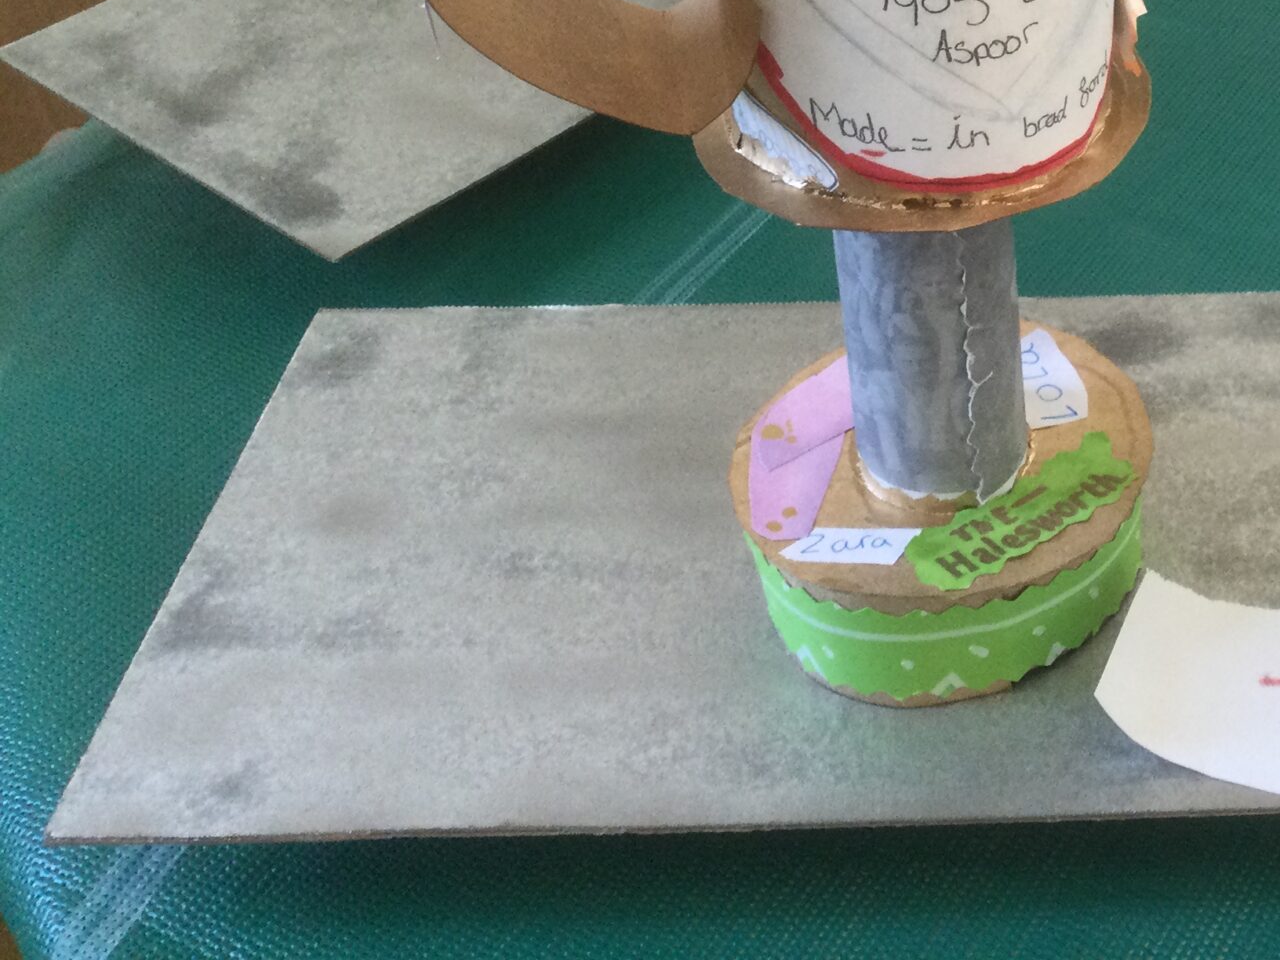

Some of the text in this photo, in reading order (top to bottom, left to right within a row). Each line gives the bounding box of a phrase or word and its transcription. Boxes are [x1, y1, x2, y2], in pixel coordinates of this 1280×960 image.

[808, 96, 906, 152] Made
[947, 115, 991, 152] in
[799, 533, 894, 555] Zara
